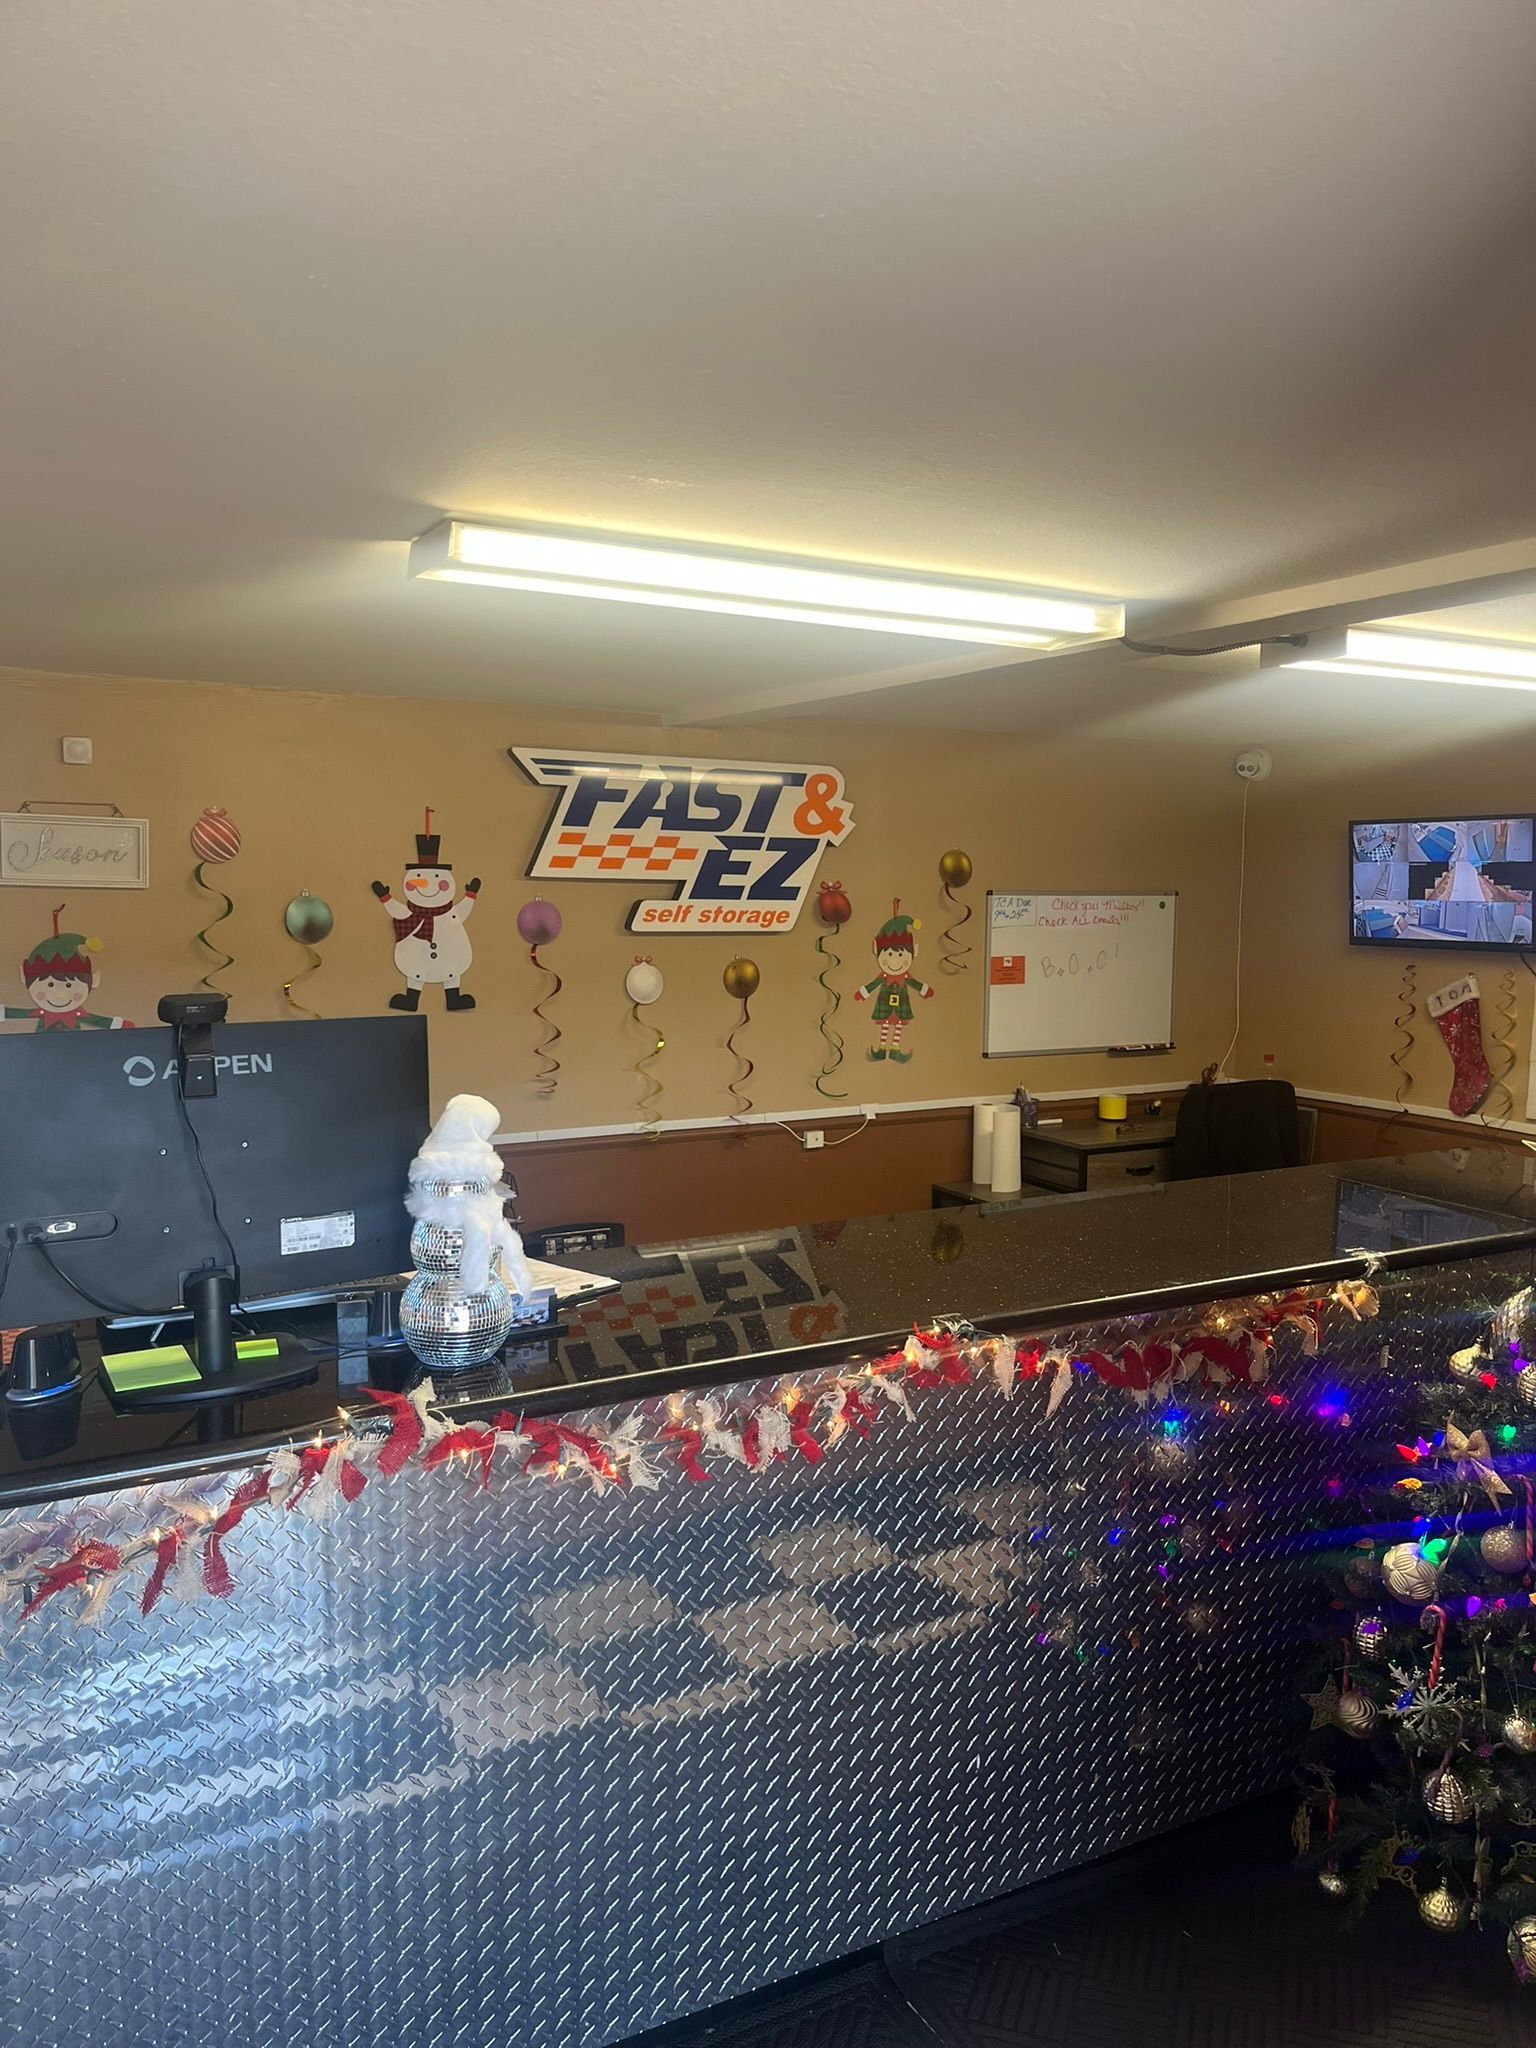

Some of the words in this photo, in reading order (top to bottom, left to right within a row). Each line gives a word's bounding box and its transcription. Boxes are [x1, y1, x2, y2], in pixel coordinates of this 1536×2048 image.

[531, 757, 807, 833] FAST
[793, 773, 846, 836] &
[8, 826, 128, 872] Season
[688, 835, 821, 901] EZ
[642, 904, 694, 924] self
[697, 905, 790, 928] storage
[1038, 916, 1068, 927] Check
[162, 1053, 273, 1080] APEN
